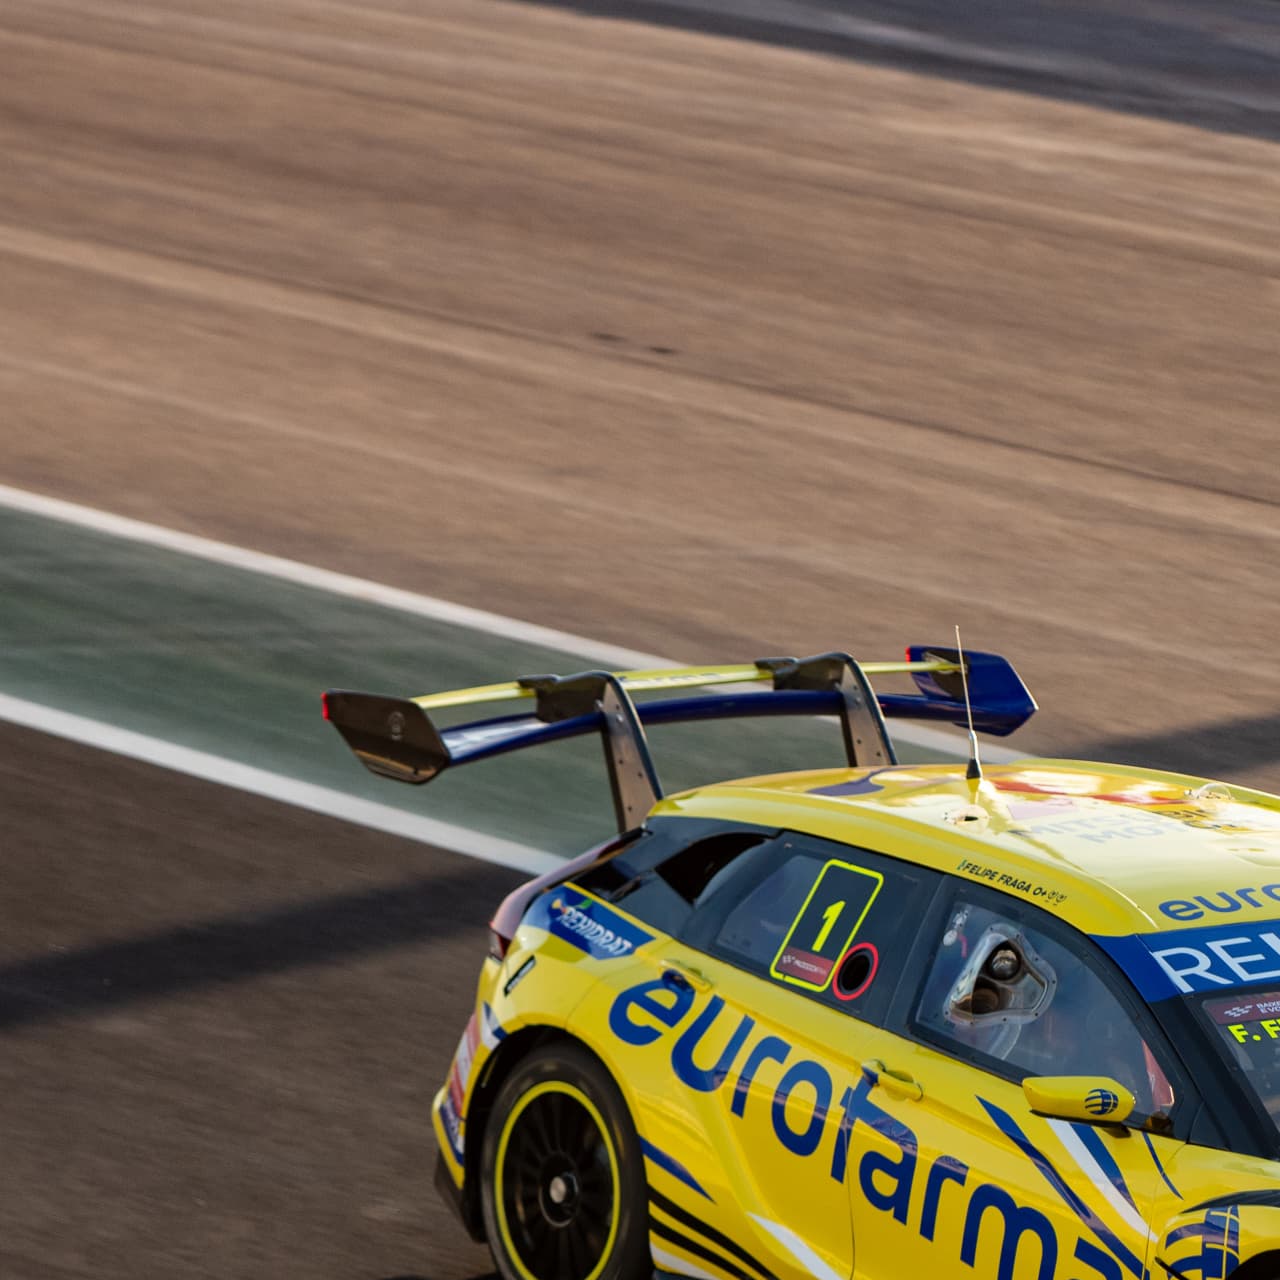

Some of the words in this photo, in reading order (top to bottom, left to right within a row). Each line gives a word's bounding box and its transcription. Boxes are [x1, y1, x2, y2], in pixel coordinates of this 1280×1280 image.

[961, 862, 999, 881] FELIPE
[996, 873, 1032, 893] FRAGA
[557, 905, 633, 956] REHIDRAT
[812, 900, 846, 952] 1
[1227, 1024, 1263, 1043] F.
